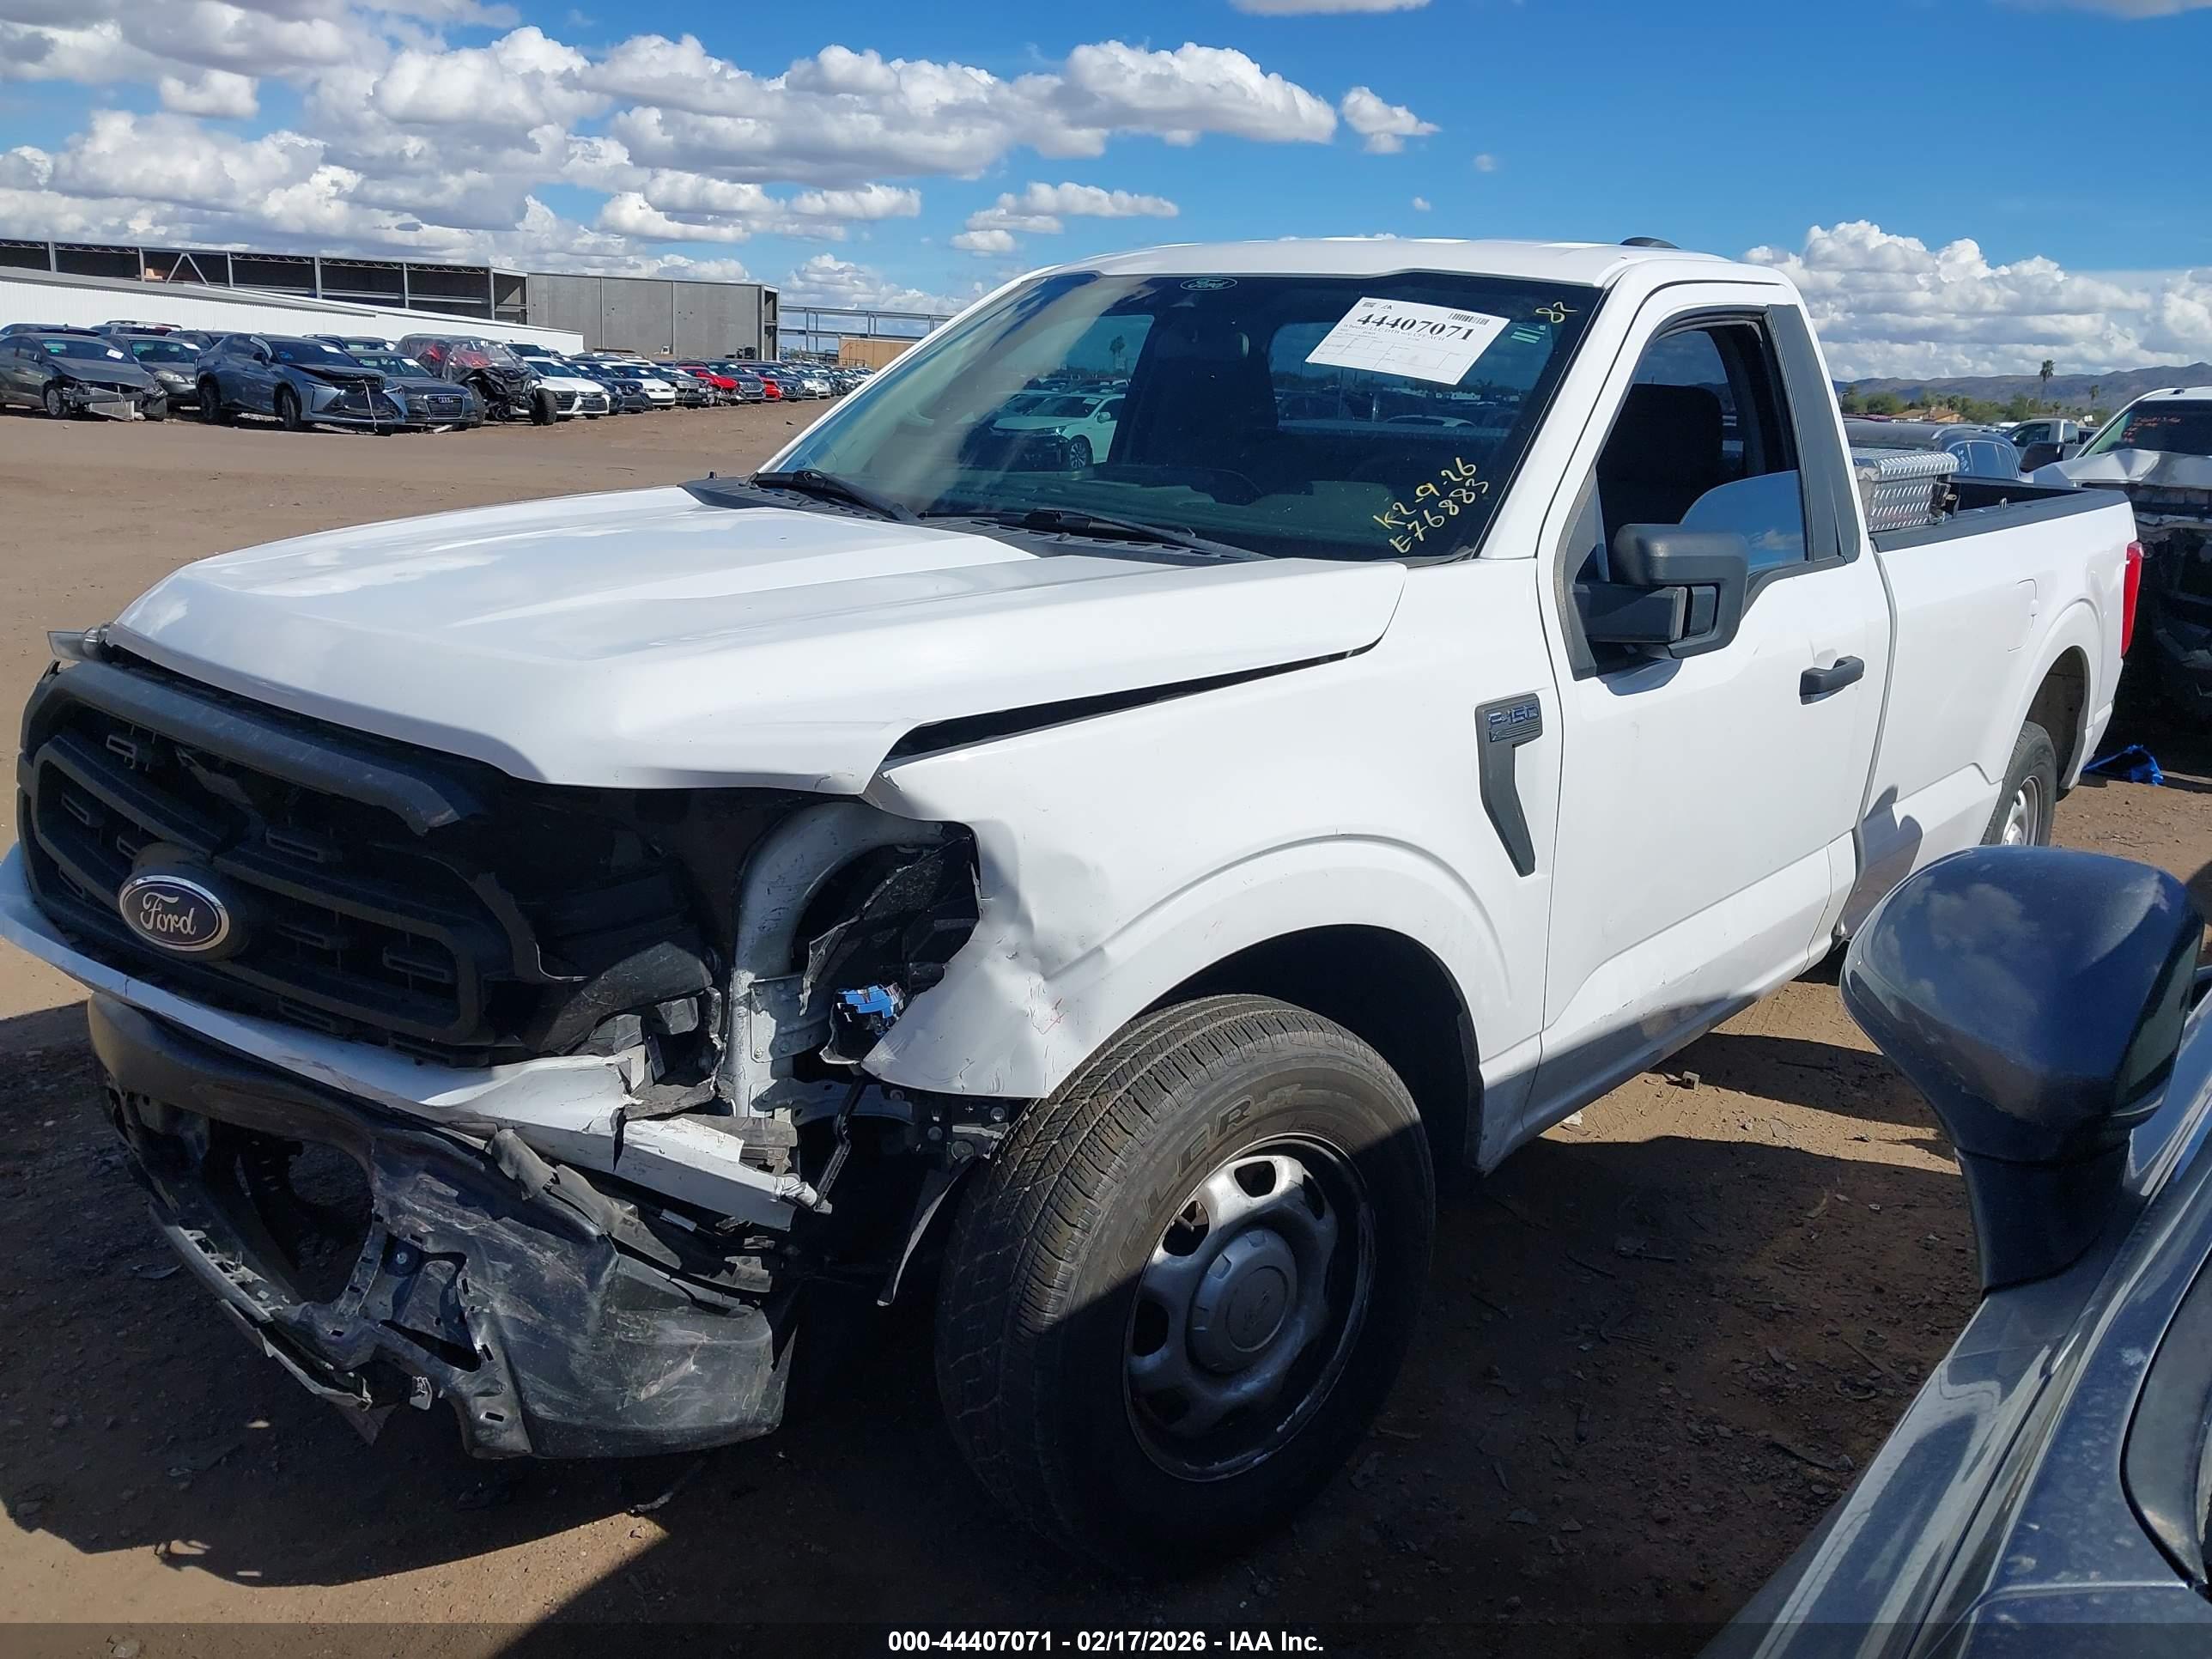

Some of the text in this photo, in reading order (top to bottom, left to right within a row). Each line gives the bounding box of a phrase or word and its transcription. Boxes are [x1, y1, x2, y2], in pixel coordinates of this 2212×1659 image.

[1357, 313, 1475, 341] 44407071
[1488, 705, 1540, 728] F-150
[140, 892, 197, 935] Ford
